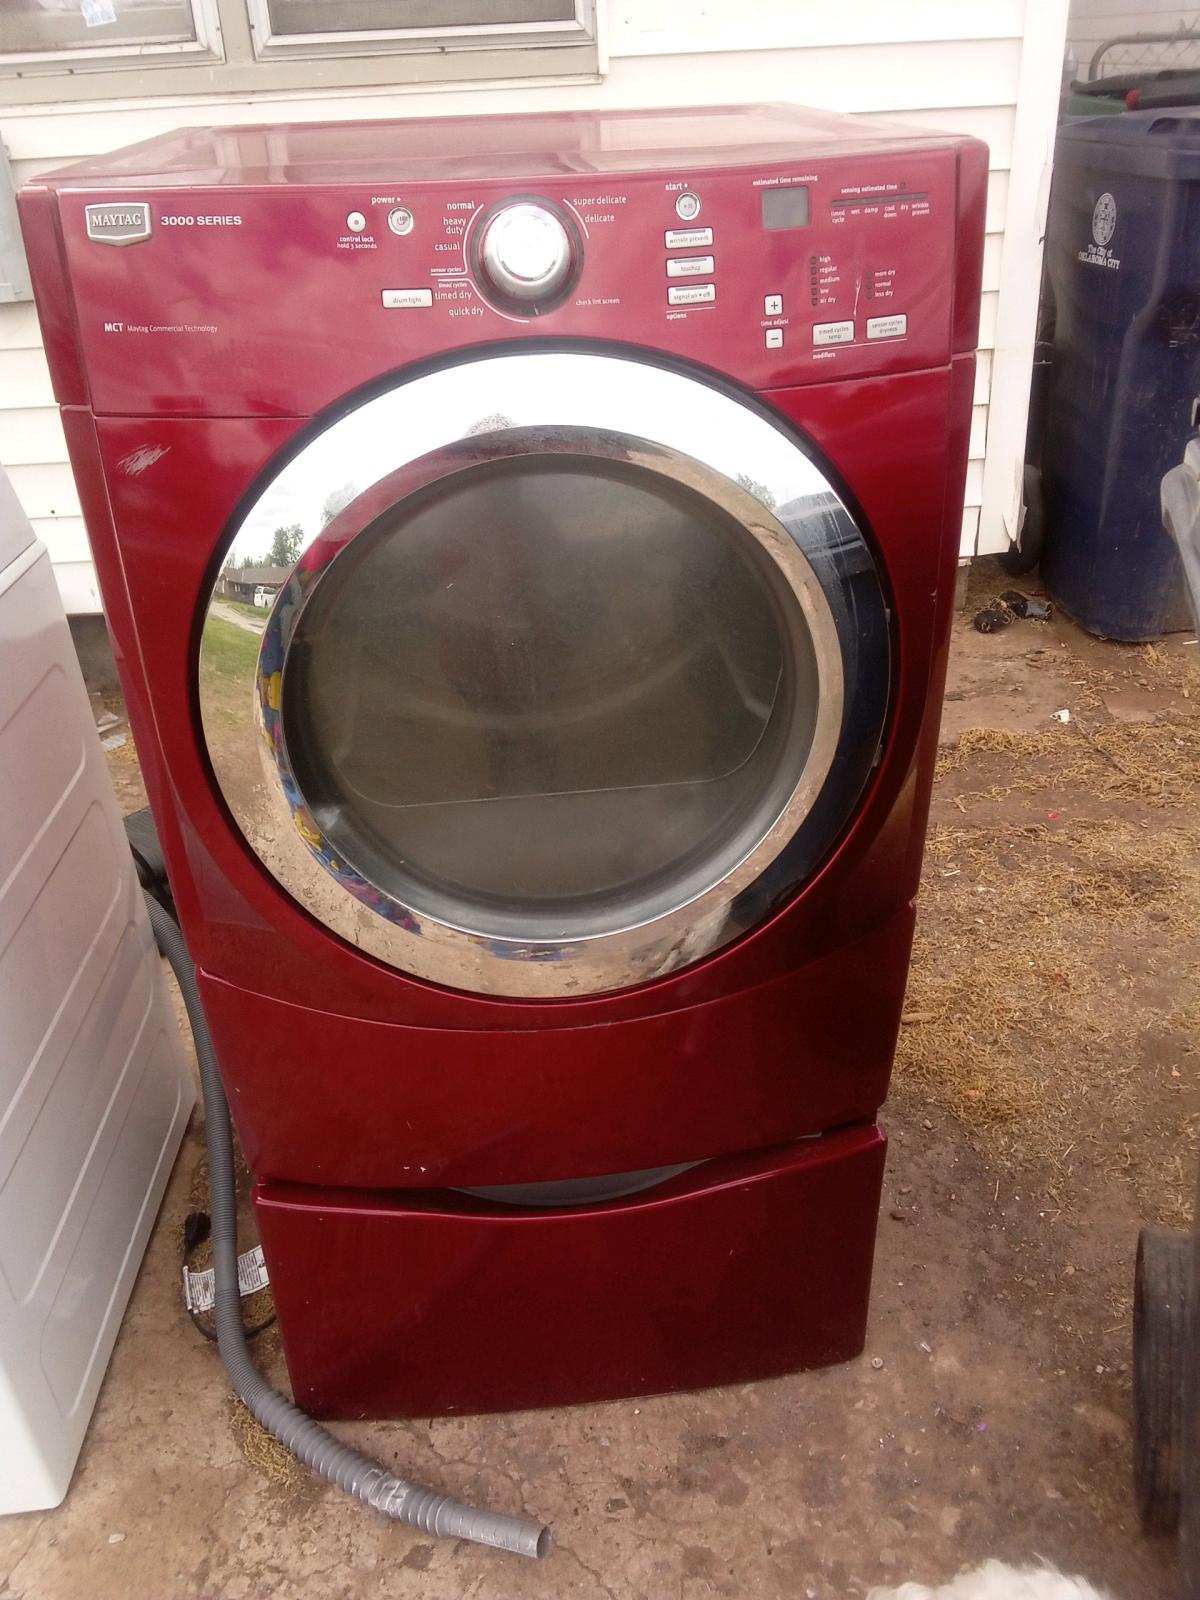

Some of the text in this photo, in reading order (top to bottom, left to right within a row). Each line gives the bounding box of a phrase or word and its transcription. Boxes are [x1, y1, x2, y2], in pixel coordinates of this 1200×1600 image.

[753, 177, 778, 186] estimated
[792, 174, 818, 182] remaining
[371, 196, 396, 204] power
[573, 195, 626, 207] super delicate
[446, 201, 475, 210] normal
[91, 213, 142, 226] MAYTAG
[161, 216, 242, 226] 3000 SERIES
[443, 217, 466, 226] heavy
[584, 214, 616, 222] delicate
[446, 226, 464, 234] duty
[434, 242, 460, 250] casual
[1107, 258, 1120, 269] CITY
[820, 266, 838, 274] regular
[434, 290, 472, 300] timed dry
[448, 306, 484, 316] quick dry
[666, 312, 688, 320] options
[772, 318, 789, 326] adjust
[104, 322, 218, 332] MCT Maytag Commercial Technology
